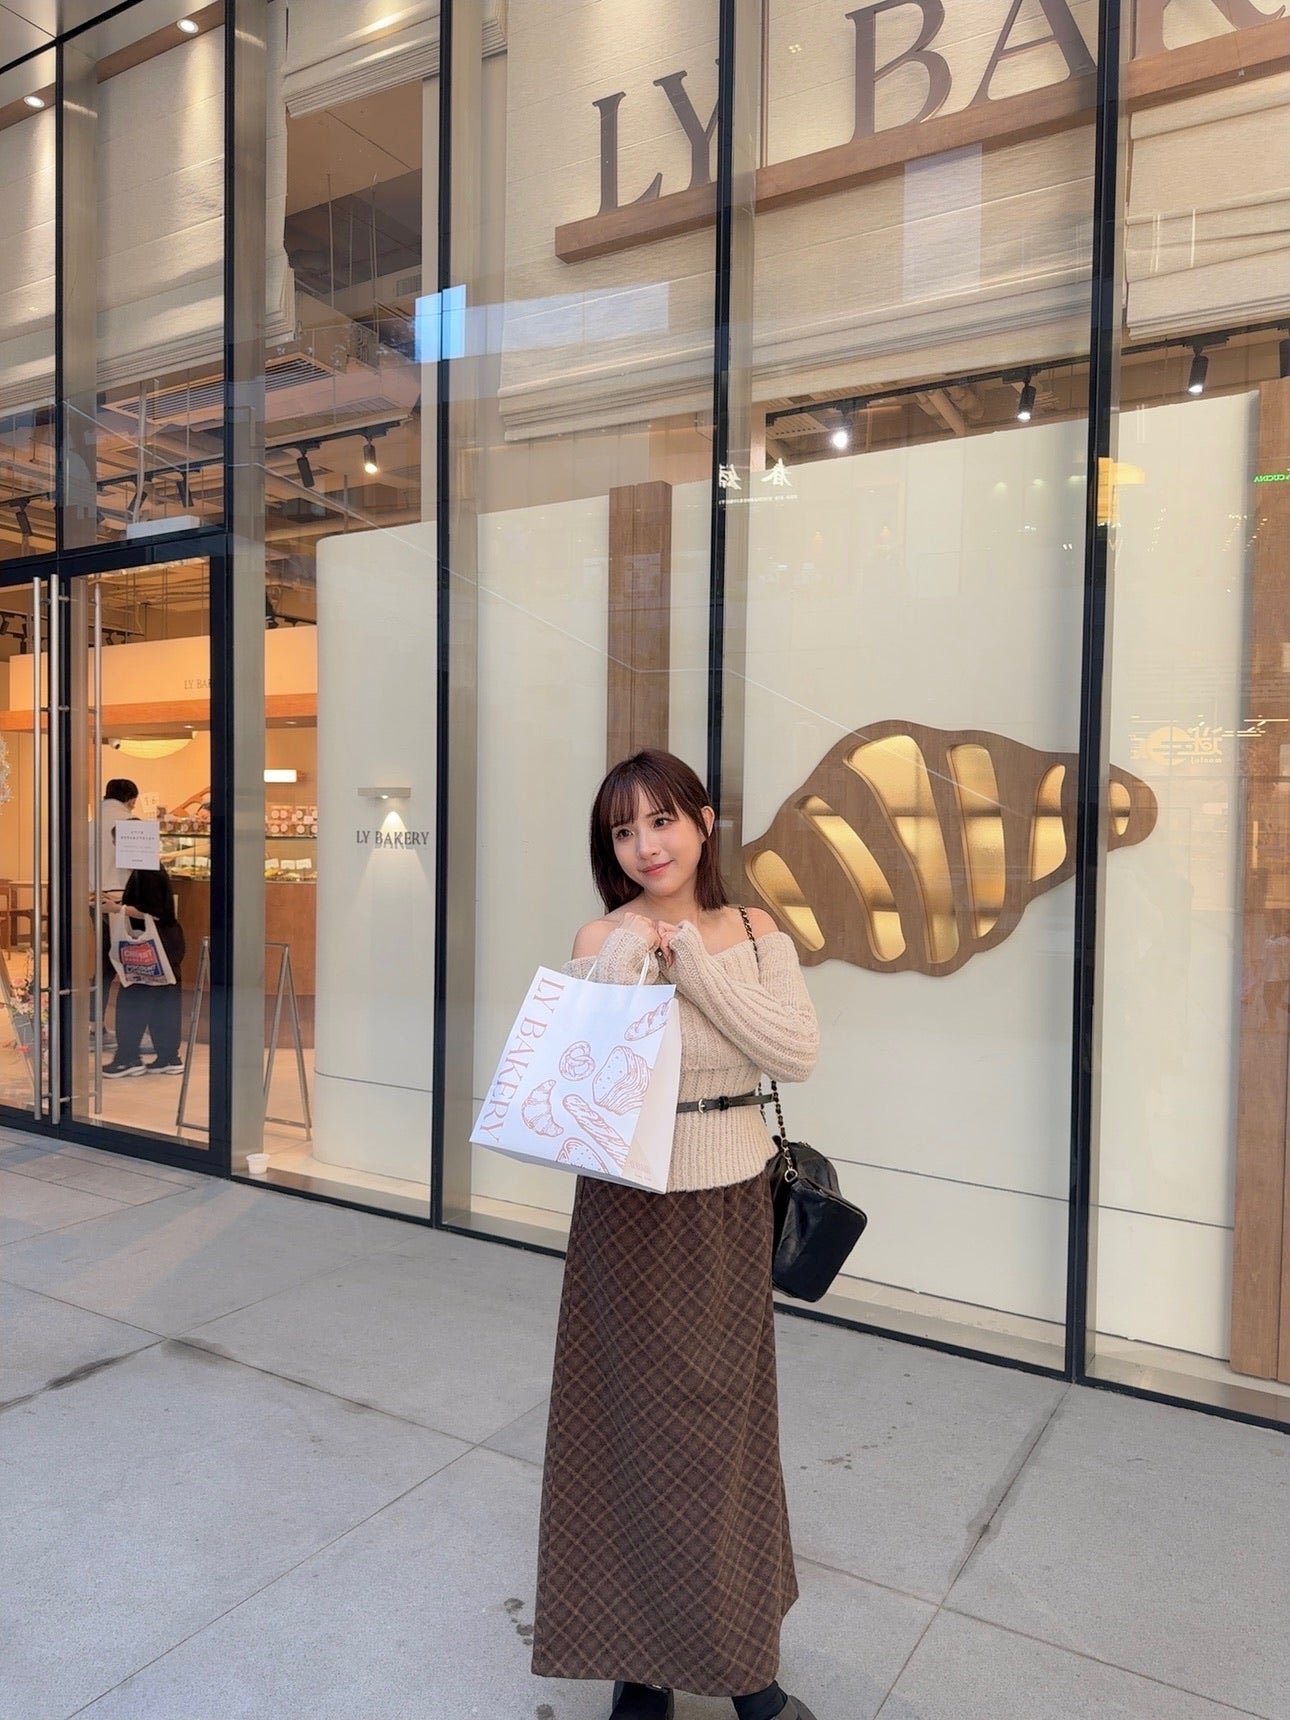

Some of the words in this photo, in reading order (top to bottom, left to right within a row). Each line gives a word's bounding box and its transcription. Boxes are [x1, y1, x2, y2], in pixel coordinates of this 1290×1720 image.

[592, 58, 719, 217] LY
[356, 830, 371, 844] LY
[375, 830, 430, 846] BAKERY
[532, 977, 565, 1014] LY
[479, 1016, 548, 1142] BAKERY
